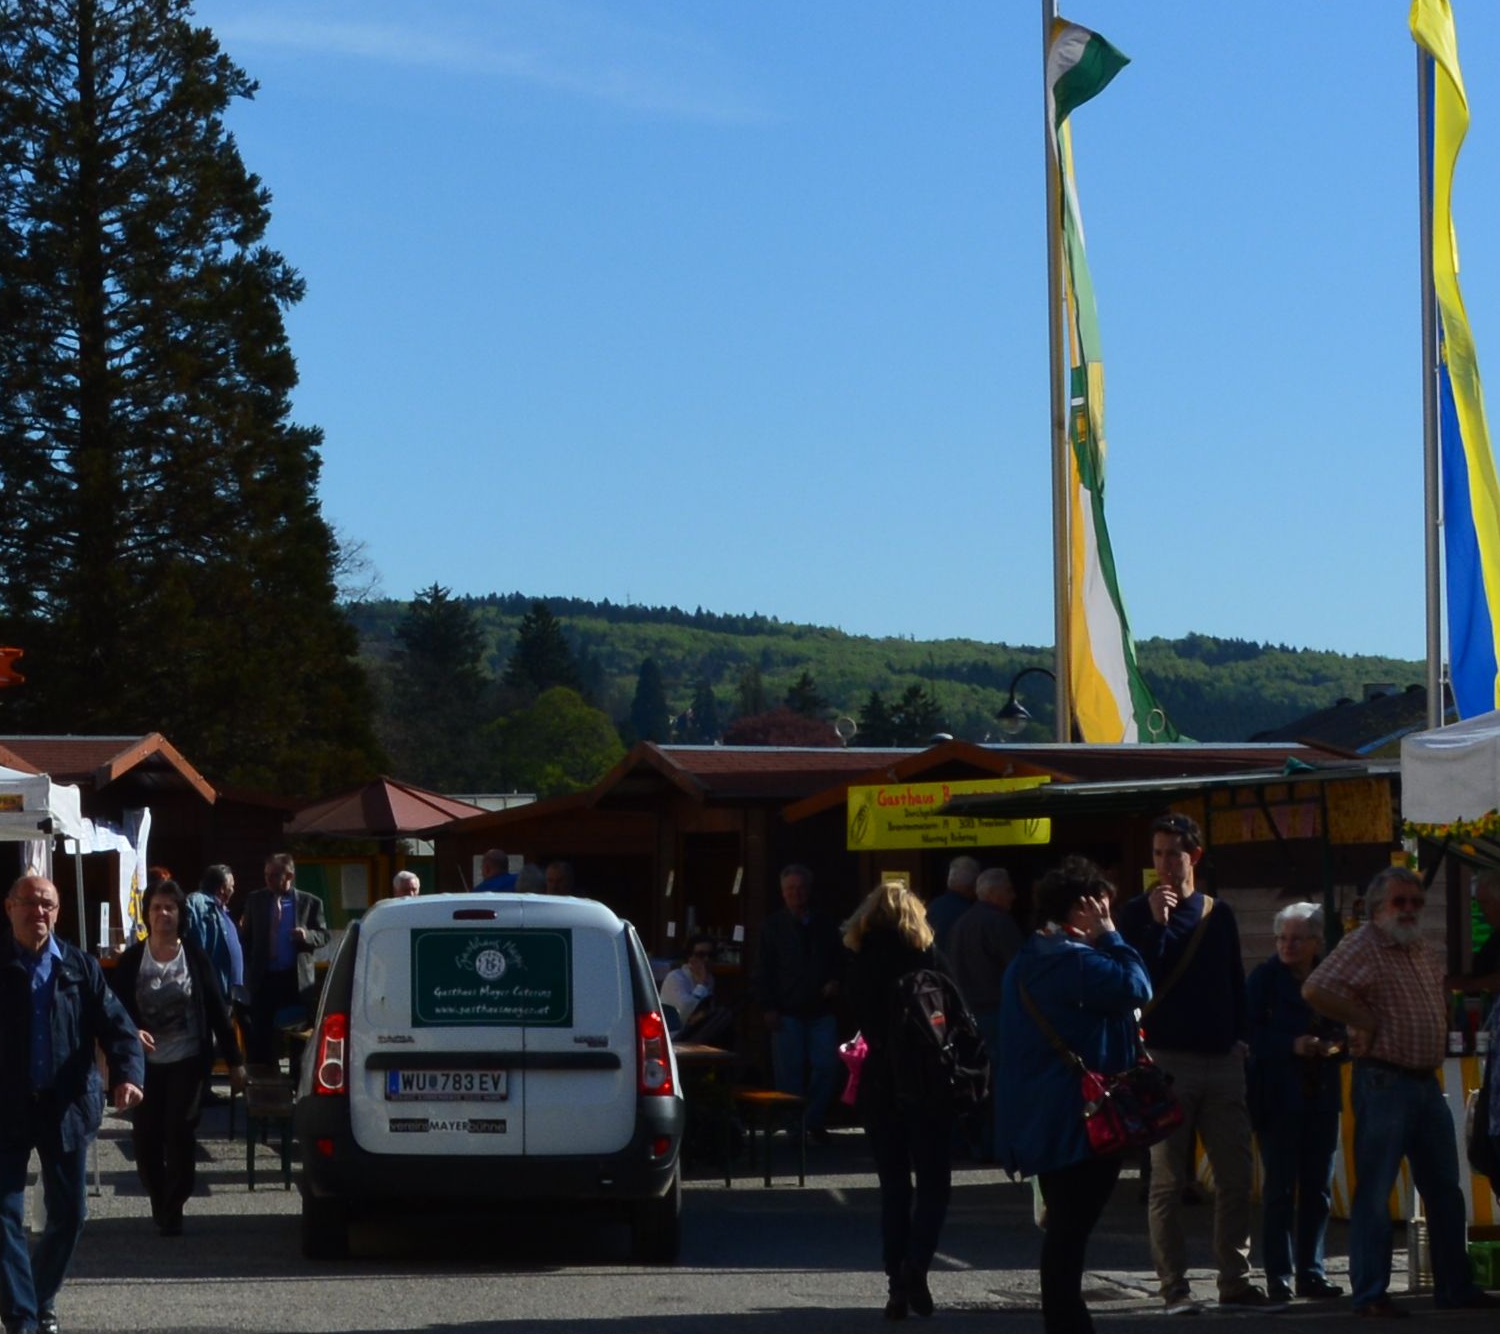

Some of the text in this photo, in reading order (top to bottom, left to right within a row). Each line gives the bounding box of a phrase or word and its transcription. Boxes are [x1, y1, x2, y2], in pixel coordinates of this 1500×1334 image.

[877, 786, 937, 807] Gasthaus
[401, 1072, 501, 1091] WU 783 EV
